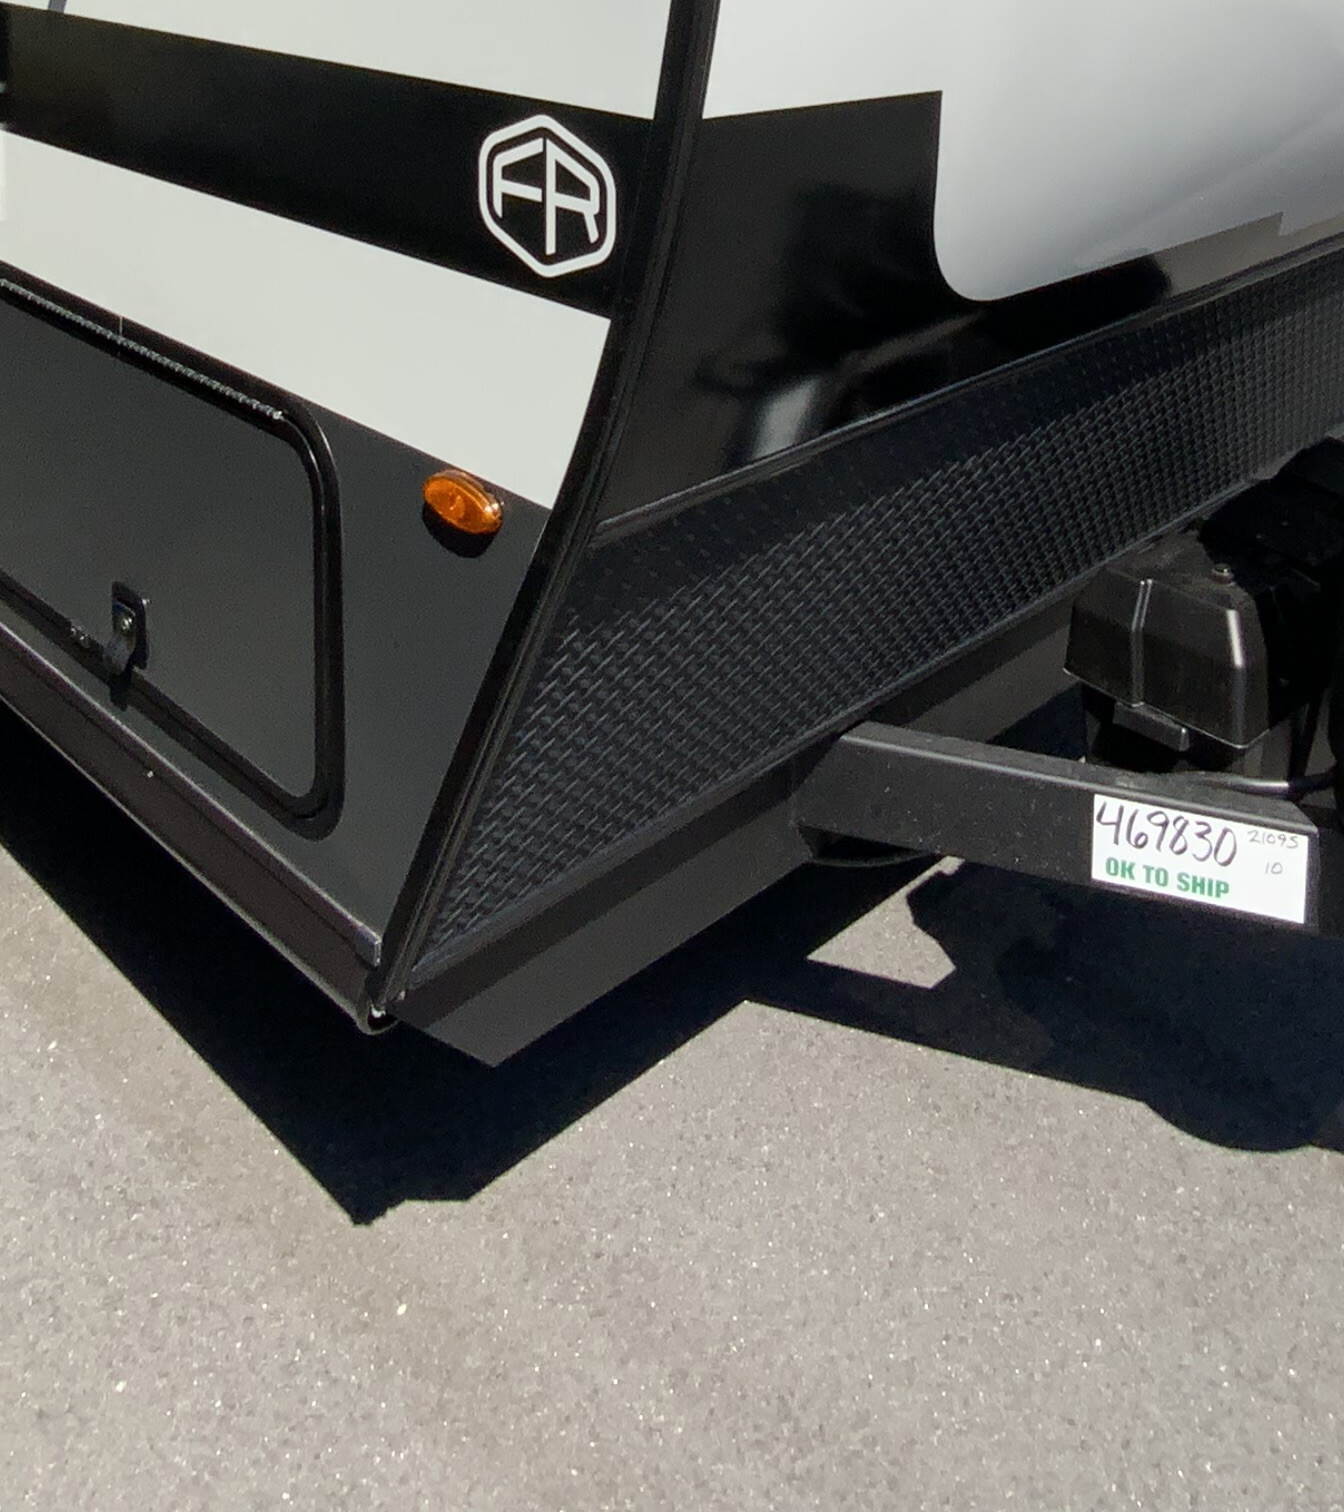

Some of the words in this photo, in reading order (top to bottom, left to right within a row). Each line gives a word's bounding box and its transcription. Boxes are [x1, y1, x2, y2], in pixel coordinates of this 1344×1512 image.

[1096, 801, 1238, 867] 469830
[1105, 856, 1136, 881] OK
[1142, 864, 1169, 888] TO
[1176, 871, 1230, 899] SHIP
[1264, 861, 1283, 876] 10
